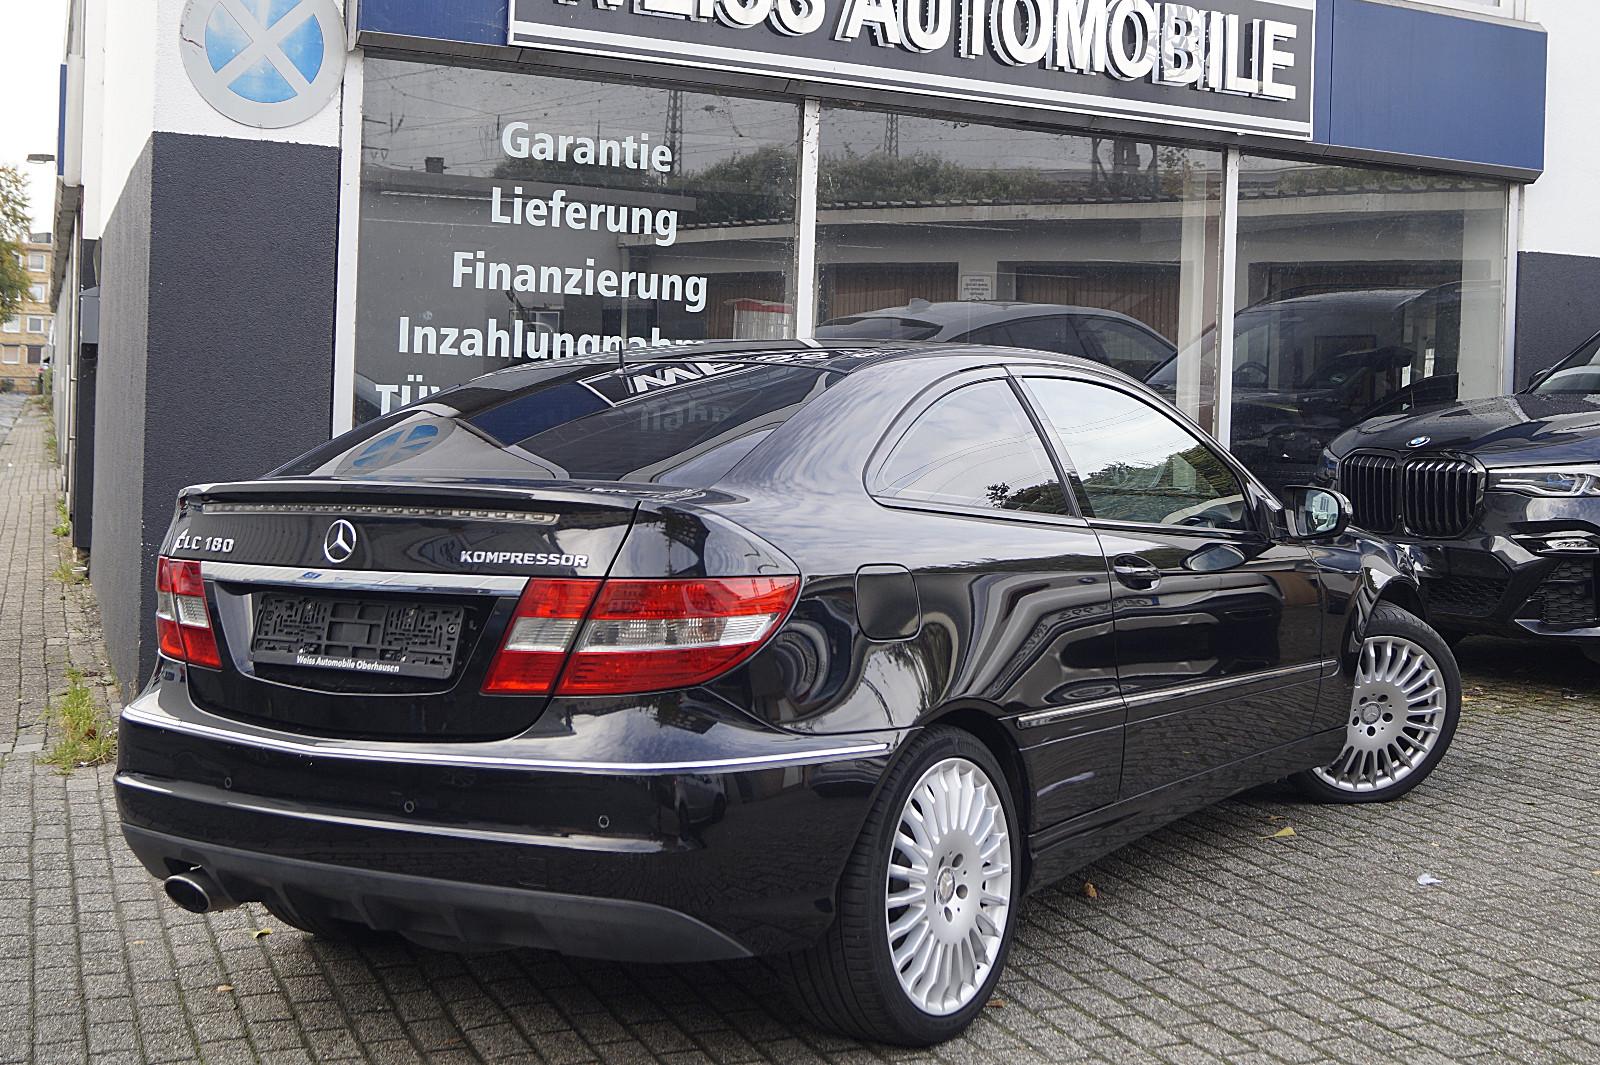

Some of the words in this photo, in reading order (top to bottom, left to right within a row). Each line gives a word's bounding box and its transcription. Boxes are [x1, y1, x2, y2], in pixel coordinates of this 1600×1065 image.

[836, 0, 1297, 101] AUTOMOBILE
[501, 121, 673, 173] Garantie
[491, 186, 678, 247] Lieferung
[452, 250, 708, 314] Finanzierung
[398, 316, 704, 360] Inzahlungn
[375, 374, 441, 416] TÜ
[174, 535, 202, 550] CLC
[205, 536, 235, 553] 180
[460, 550, 589, 568] KOMPRESSOR
[296, 655, 315, 665] Weiss
[316, 656, 355, 668] Automobile
[356, 660, 399, 672] Oberhausen
